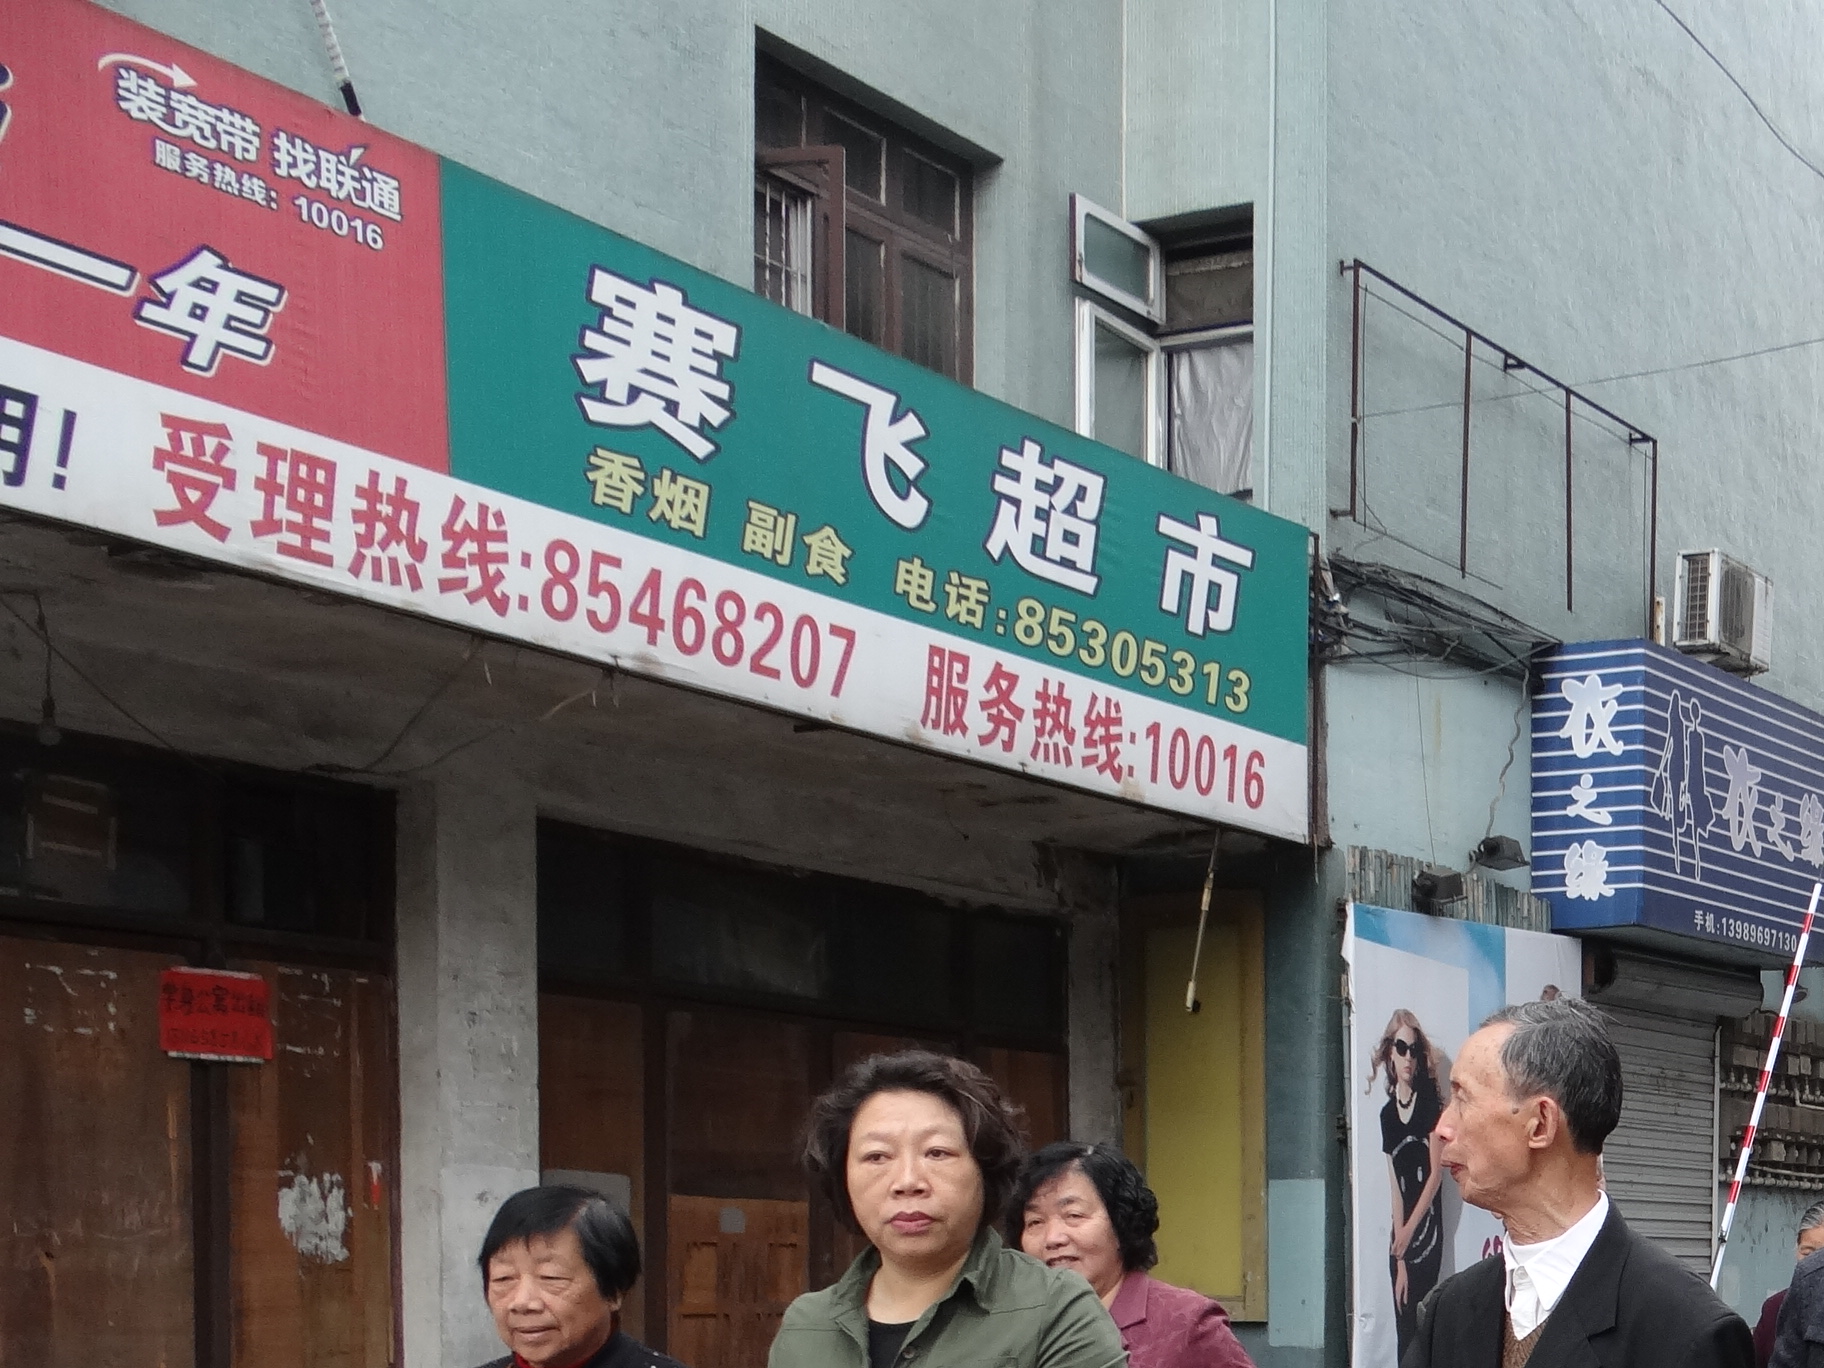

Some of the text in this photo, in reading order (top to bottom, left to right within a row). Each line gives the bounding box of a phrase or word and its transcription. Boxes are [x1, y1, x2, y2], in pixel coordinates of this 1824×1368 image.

[117, 68, 260, 162] 装宽带
[272, 130, 402, 222] 找联通
[294, 196, 385, 251] 10016
[570, 264, 1257, 638] 赛飞超市
[151, 412, 1266, 812] 受理热线:85468207 服务热线:10016
[585, 447, 1252, 715] 香烟 副食 电话:85305313
[1694, 909, 1797, 953] 手机:13989697130
